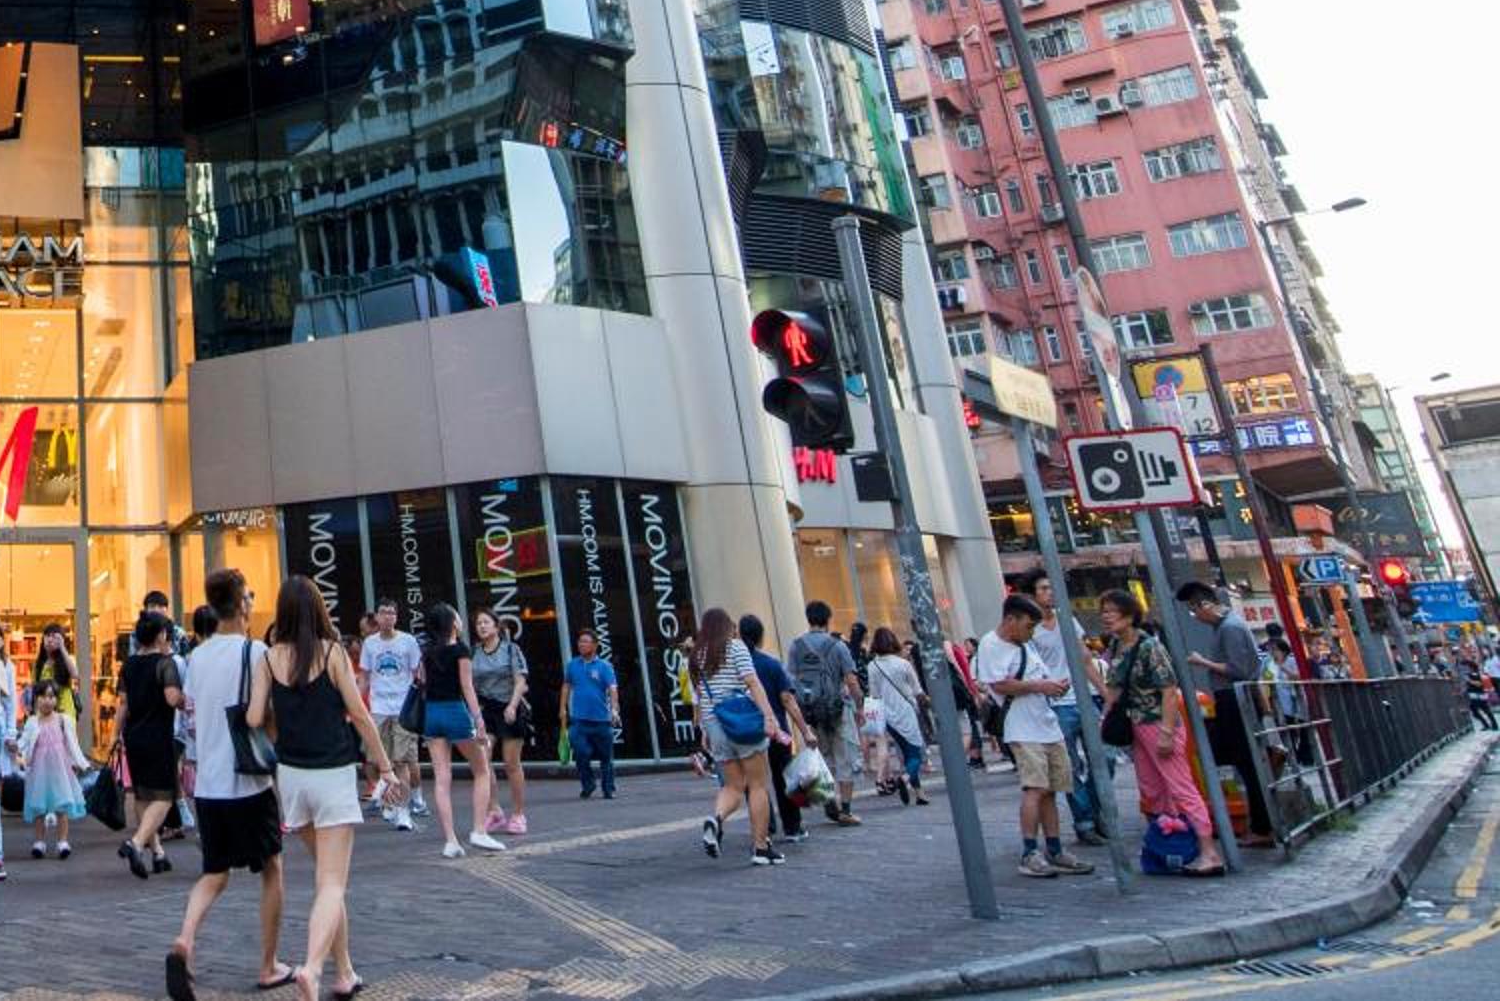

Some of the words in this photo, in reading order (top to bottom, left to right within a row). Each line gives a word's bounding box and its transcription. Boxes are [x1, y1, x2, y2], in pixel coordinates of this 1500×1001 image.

[308, 512, 341, 639] MOVIN
[400, 504, 421, 583] HM.COM
[576, 489, 600, 571] HM.COM
[588, 575, 604, 594] IS
[1319, 560, 1334, 578] P
[407, 589, 423, 604] IS
[639, 493, 680, 639] MOVING
[663, 648, 696, 743] SALE
